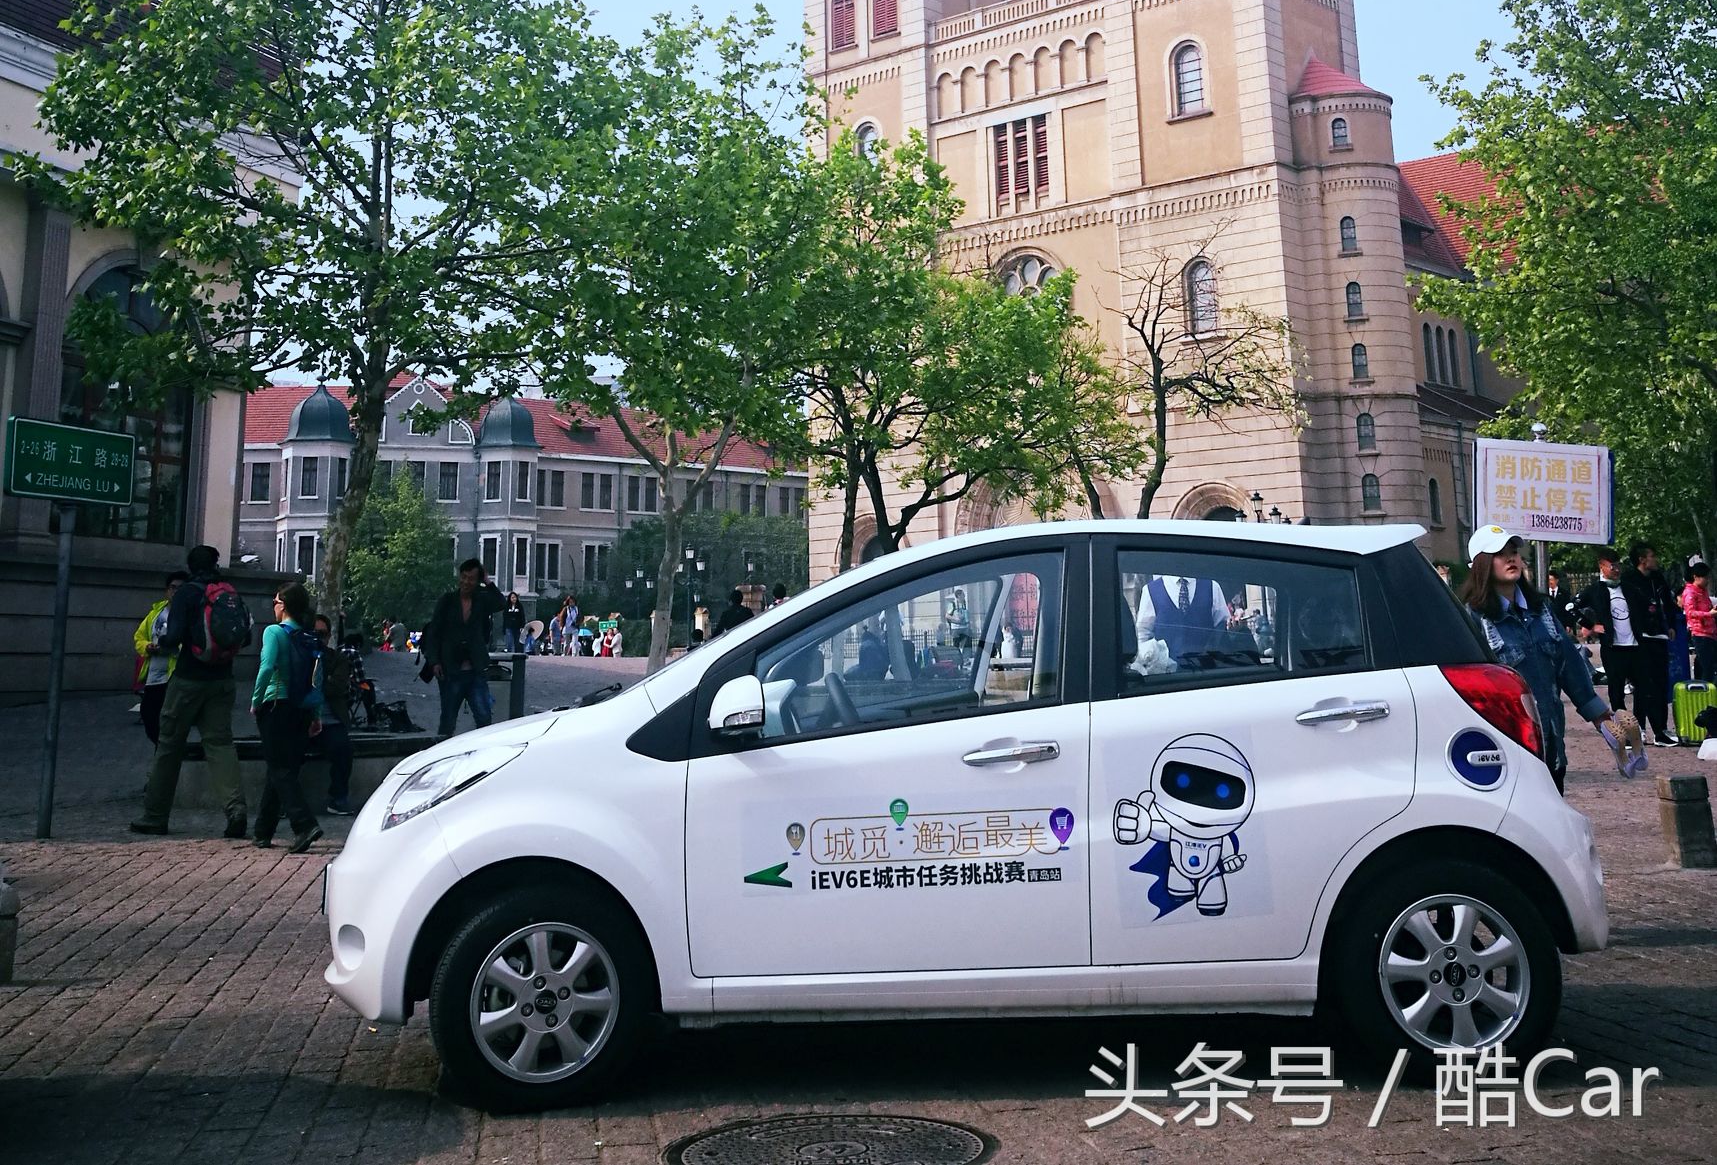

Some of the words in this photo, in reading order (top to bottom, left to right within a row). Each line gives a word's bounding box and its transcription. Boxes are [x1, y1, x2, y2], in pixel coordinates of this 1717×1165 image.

[20, 440, 40, 455] 2-26
[42, 440, 107, 468] 浙江路
[36, 473, 91, 490] ZHEJIANG
[96, 479, 110, 492] LU
[1495, 454, 1593, 485] 消防通道
[1495, 484, 1593, 515] 禁止停车
[1531, 514, 1583, 531] 13864238775
[811, 860, 1026, 890] iEV6E城市任务挑战赛
[1028, 868, 1061, 882] 青岛站
